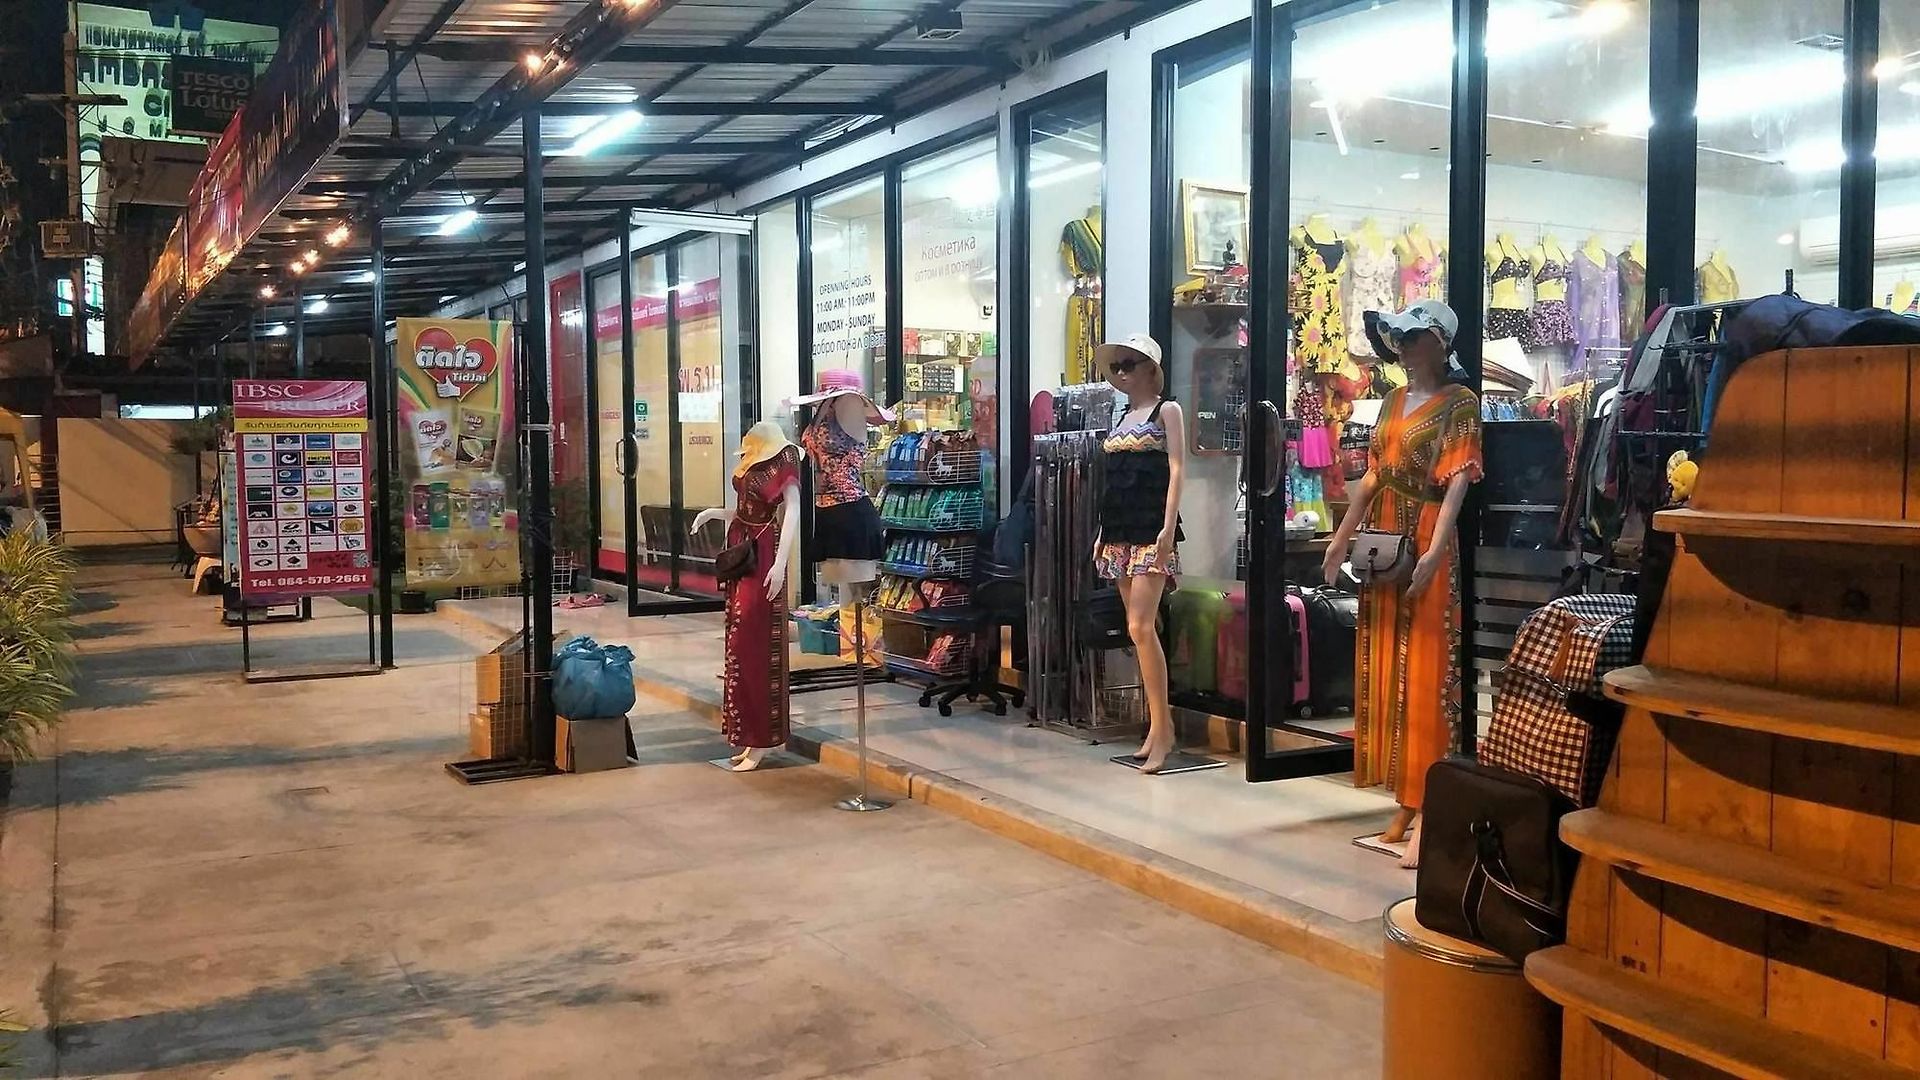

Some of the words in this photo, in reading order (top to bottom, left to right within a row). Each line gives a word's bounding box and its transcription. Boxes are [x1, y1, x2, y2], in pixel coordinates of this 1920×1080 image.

[178, 70, 250, 91] TESCO
[851, 274, 872, 289] HOURS
[816, 318, 844, 333] MONDAY
[848, 313, 876, 329] SUNDAY
[235, 384, 304, 399] IBSC
[251, 578, 275, 588] Tel.
